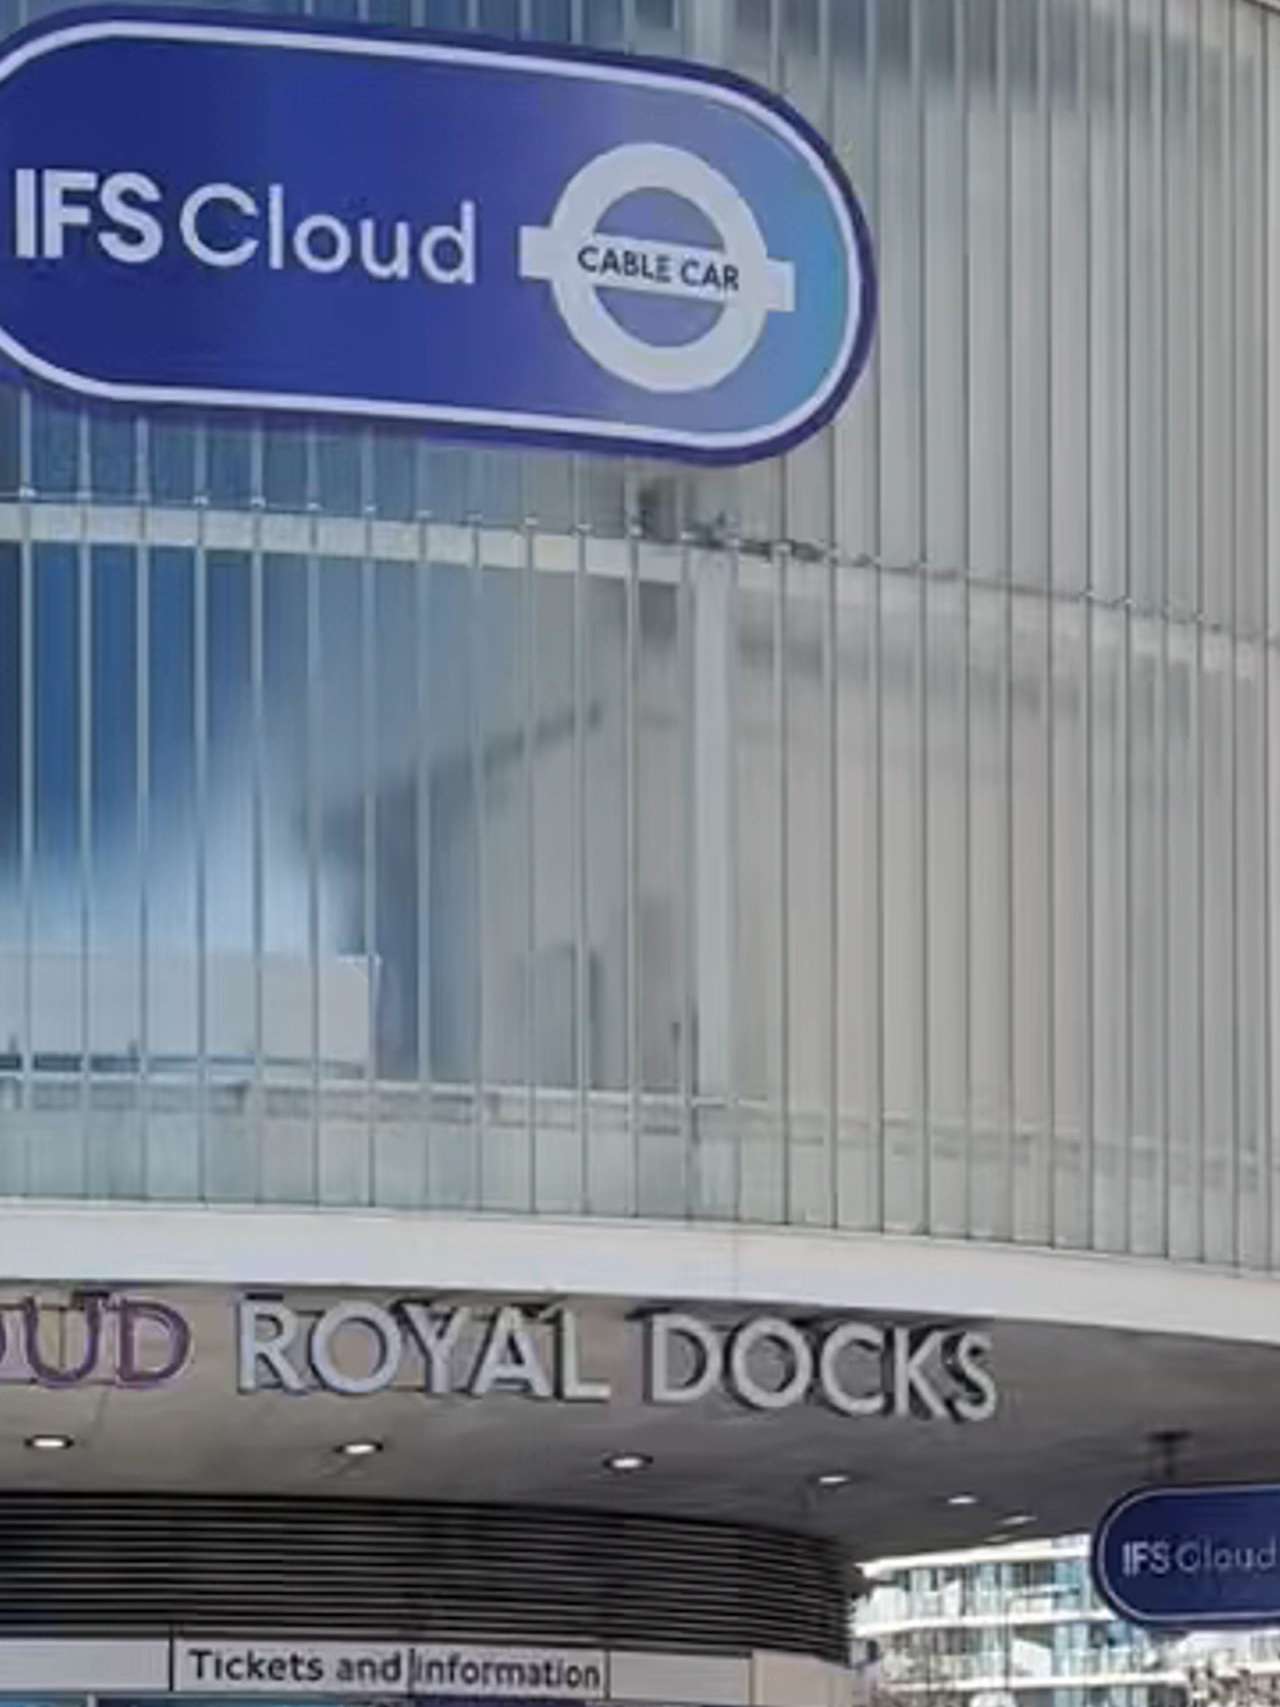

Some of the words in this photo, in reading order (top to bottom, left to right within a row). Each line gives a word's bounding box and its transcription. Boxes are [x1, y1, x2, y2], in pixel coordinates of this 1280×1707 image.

[16, 169, 163, 263] IFS
[180, 183, 475, 285] Cloud
[577, 246, 673, 283] CABLE
[681, 259, 739, 291] CAR
[236, 1297, 612, 1403] ROYAL
[647, 1311, 997, 1423] DOCKS
[1122, 1541, 1170, 1576] IFS
[1175, 1535, 1277, 1574] Cloud
[187, 1648, 324, 1682] Tickets
[336, 1651, 402, 1683] and
[416, 1652, 600, 1689] information
